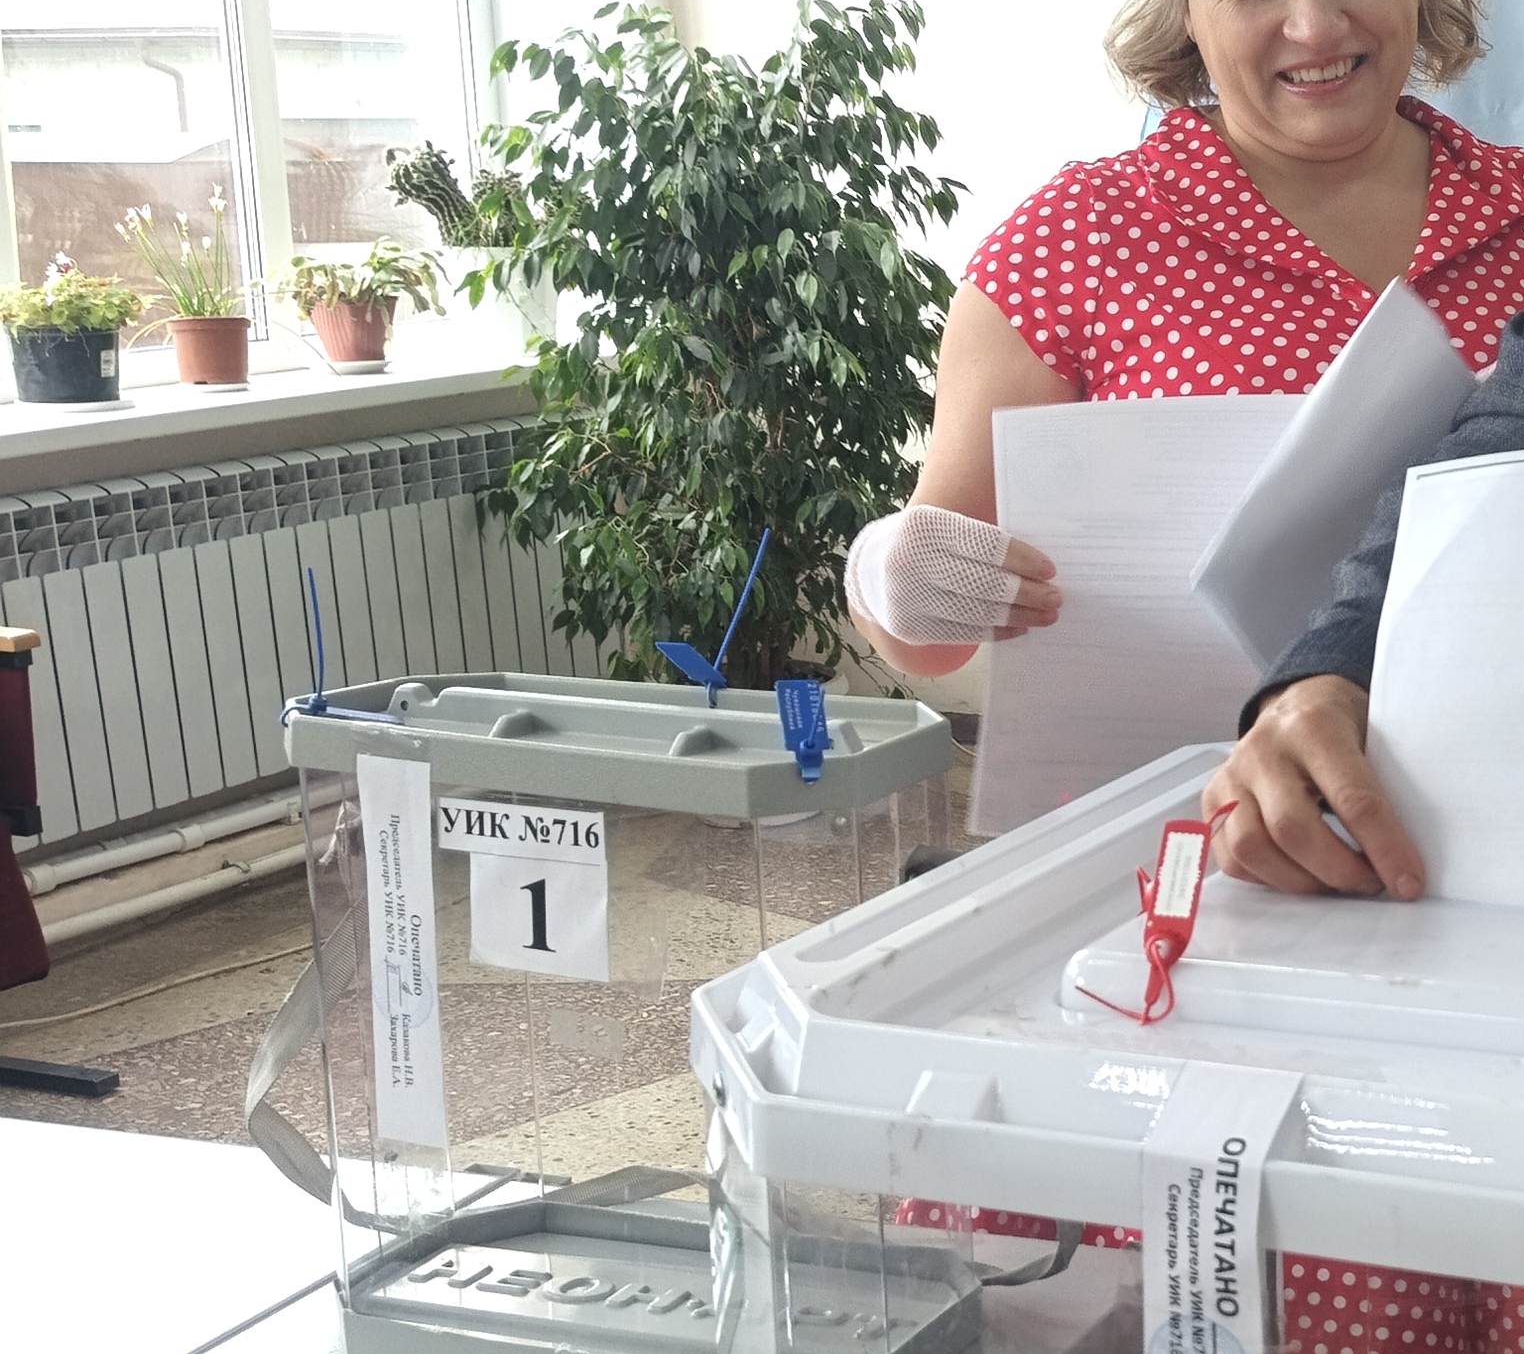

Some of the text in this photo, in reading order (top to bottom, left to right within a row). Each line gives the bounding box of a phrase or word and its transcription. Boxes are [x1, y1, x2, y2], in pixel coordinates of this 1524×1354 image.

[388, 814, 404, 891] Председатель
[439, 806, 600, 850] УИК №716
[379, 830, 394, 888] Секретарь
[384, 890, 395, 919] УИК
[396, 894, 406, 921] УИК
[520, 877, 558, 953] 1
[385, 920, 397, 953] №716
[397, 923, 407, 956] №716
[409, 914, 424, 997] Опечатано
[388, 1013, 400, 1063] Захарова
[401, 1013, 412, 1063] Казакова
[1166, 1183, 1182, 1271] Секретарь
[1188, 1166, 1204, 1285] Председатель
[1213, 1136, 1247, 1318] ОПЕЧАТАНО
[1168, 1273, 1182, 1305] УИК
[1190, 1289, 1206, 1321] УИК
